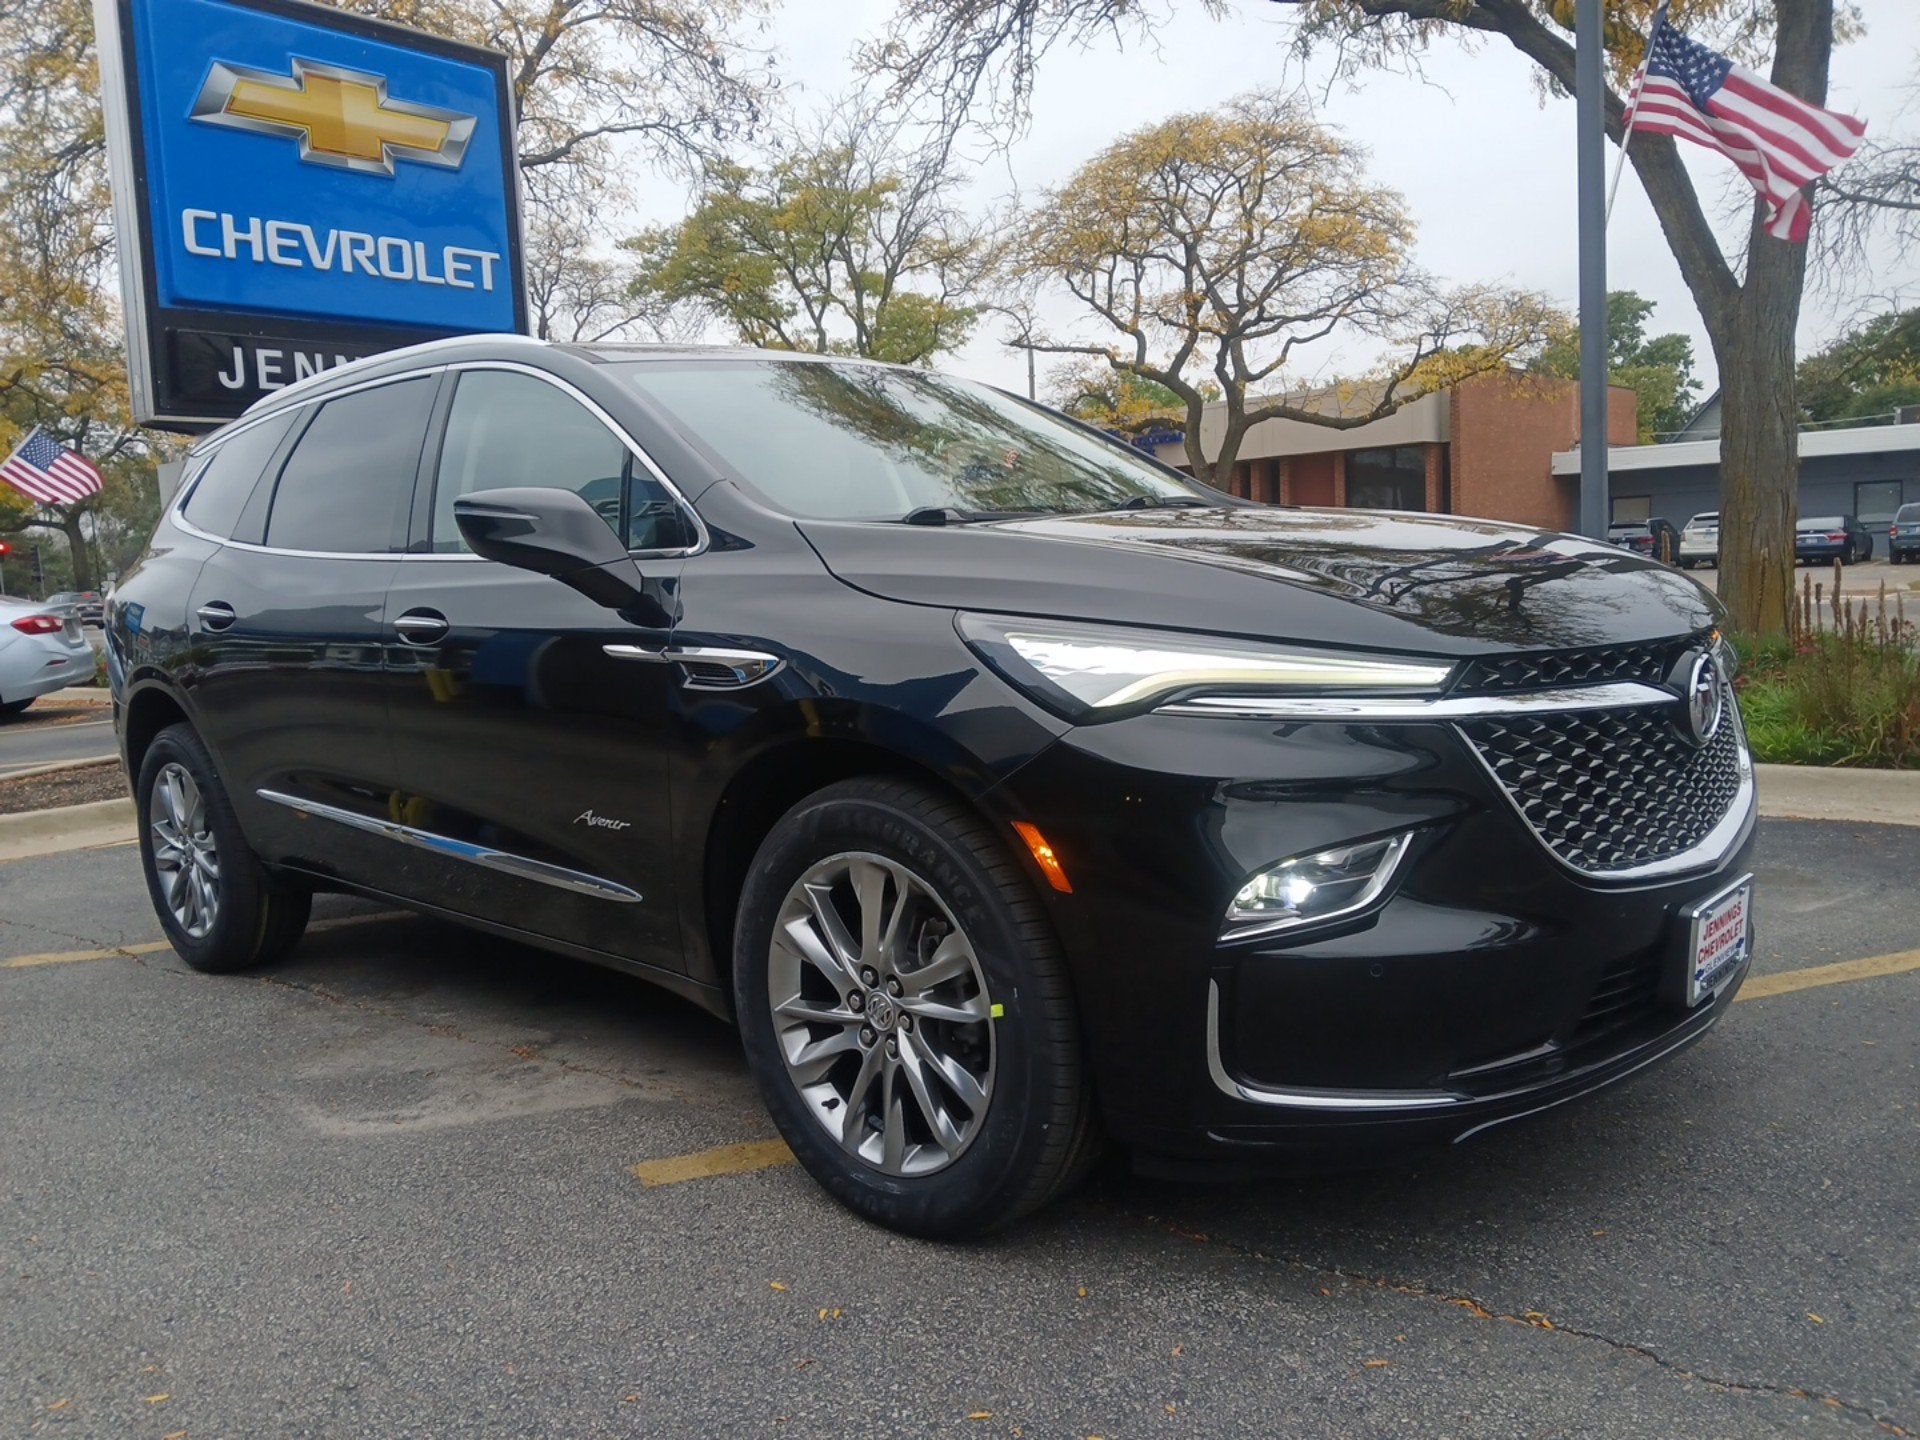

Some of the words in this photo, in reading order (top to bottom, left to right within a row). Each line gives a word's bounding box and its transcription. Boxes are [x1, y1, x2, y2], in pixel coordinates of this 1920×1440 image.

[182, 208, 500, 291] CHEVROLET
[218, 346, 361, 390] JEN
[1697, 918, 1744, 964] CHEVROLET
[1703, 901, 1742, 941] JENNINGS
